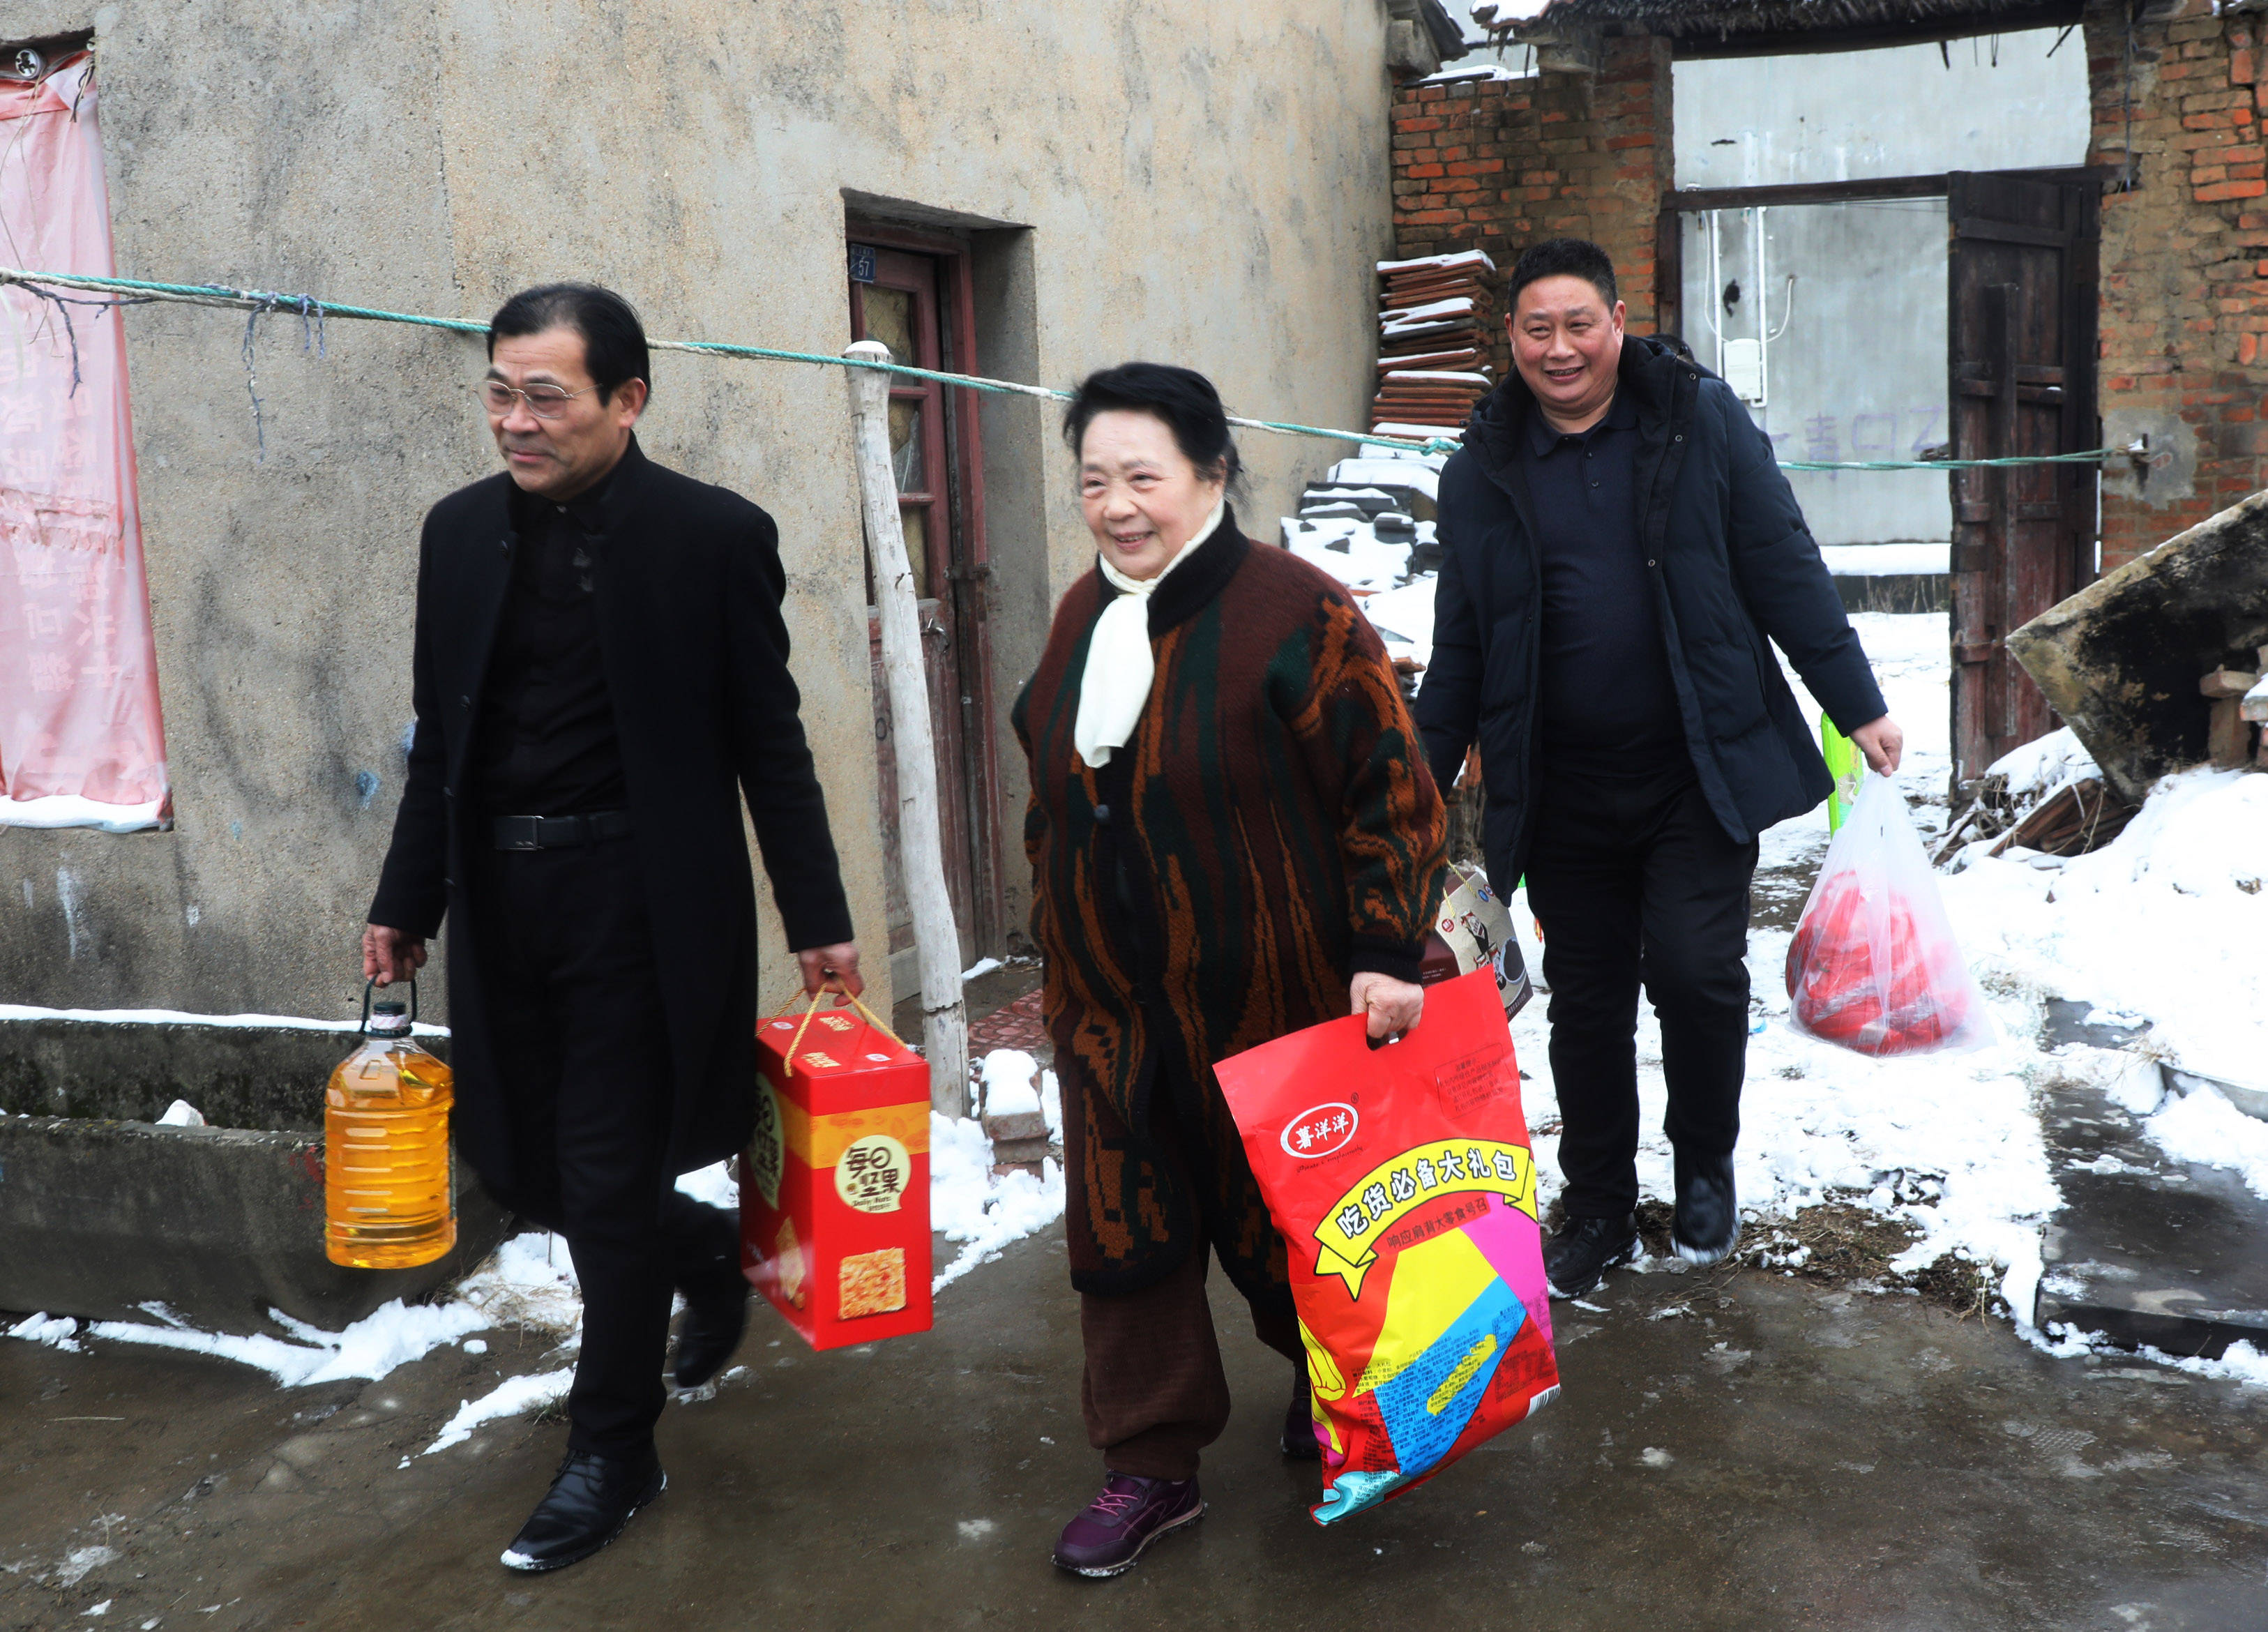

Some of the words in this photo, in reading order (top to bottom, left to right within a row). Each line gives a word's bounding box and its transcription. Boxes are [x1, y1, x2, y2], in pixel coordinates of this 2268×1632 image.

[859, 260, 869, 277] 57
[1296, 1112, 1349, 1149] 薯洋洋
[845, 1146, 891, 1179] 每日
[859, 1168, 901, 1197] 坚果
[1336, 1147, 1517, 1239] 吃货必备大礼包
